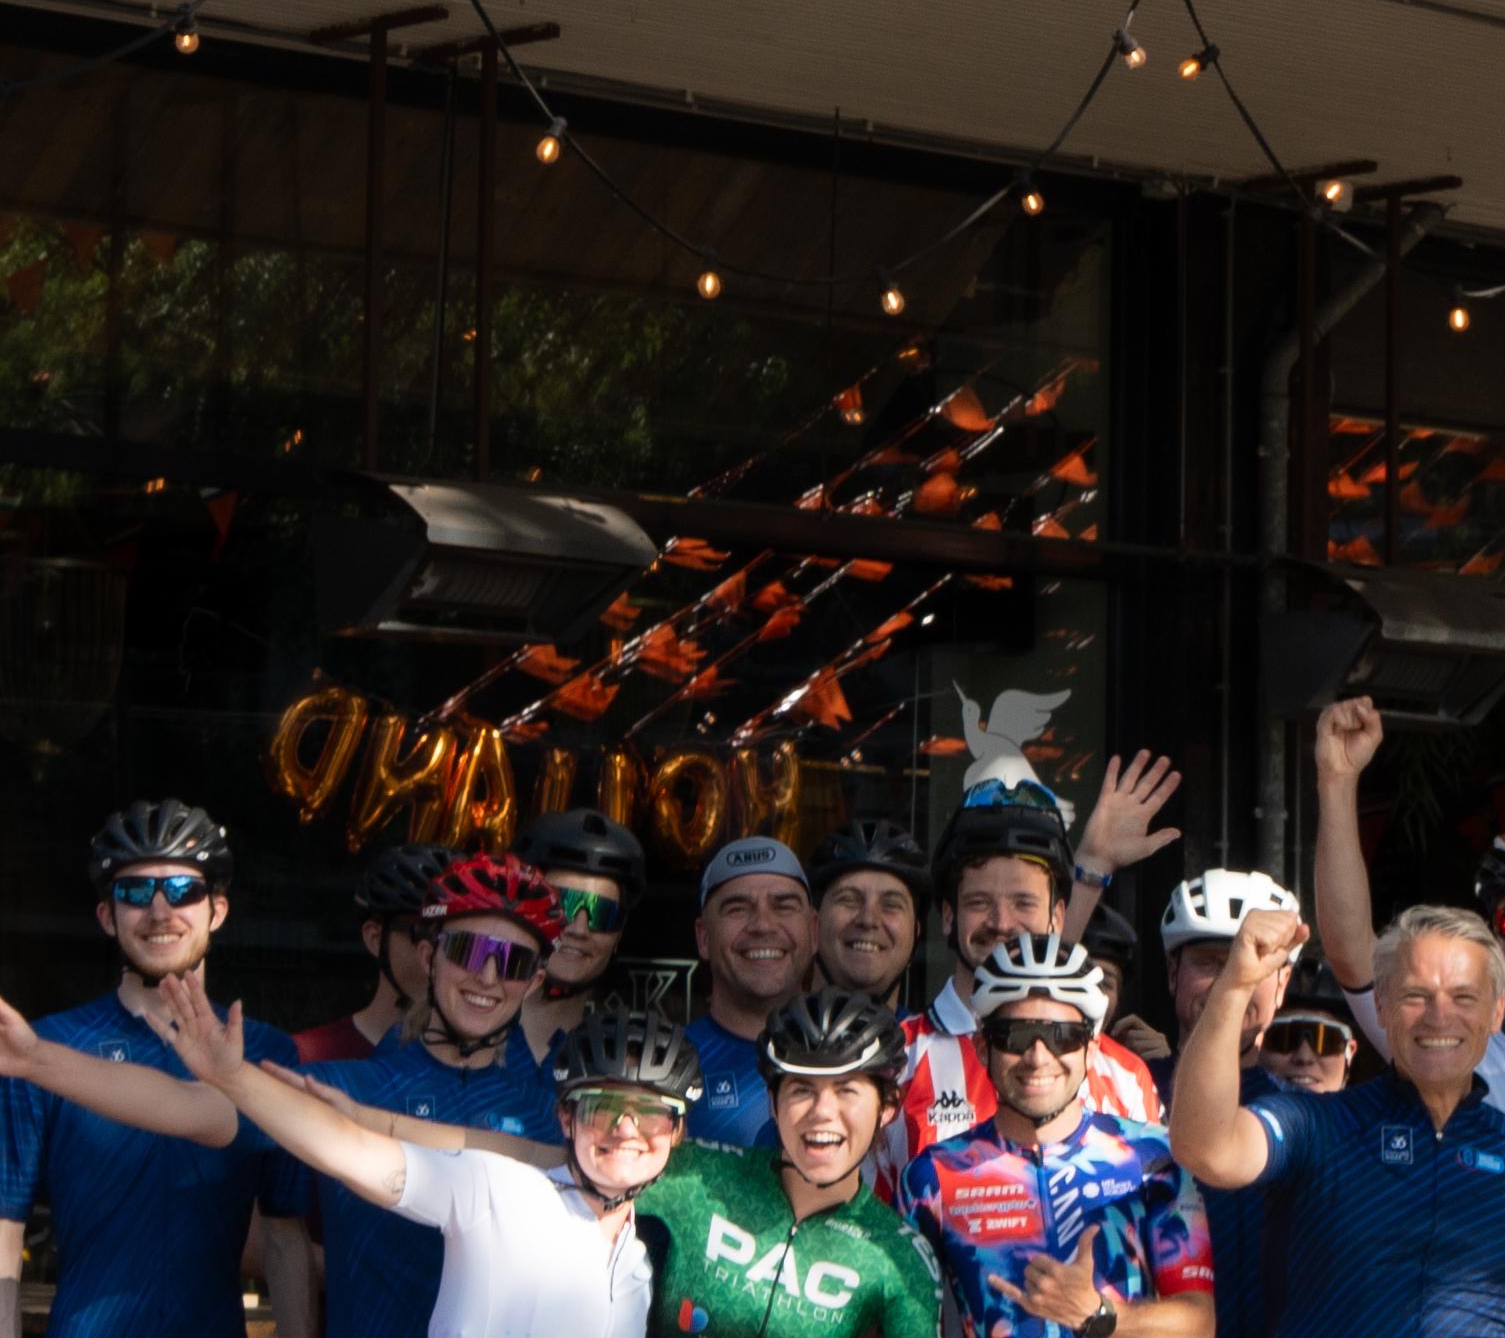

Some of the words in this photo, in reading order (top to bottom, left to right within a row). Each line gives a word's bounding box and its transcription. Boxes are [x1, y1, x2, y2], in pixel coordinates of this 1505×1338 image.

[727, 848, 774, 864] ABUS
[928, 1107, 975, 1126] Kappa
[954, 1184, 1024, 1200] SRAM
[706, 1213, 861, 1309] PAC
[704, 1260, 844, 1324] TRIATHLON
